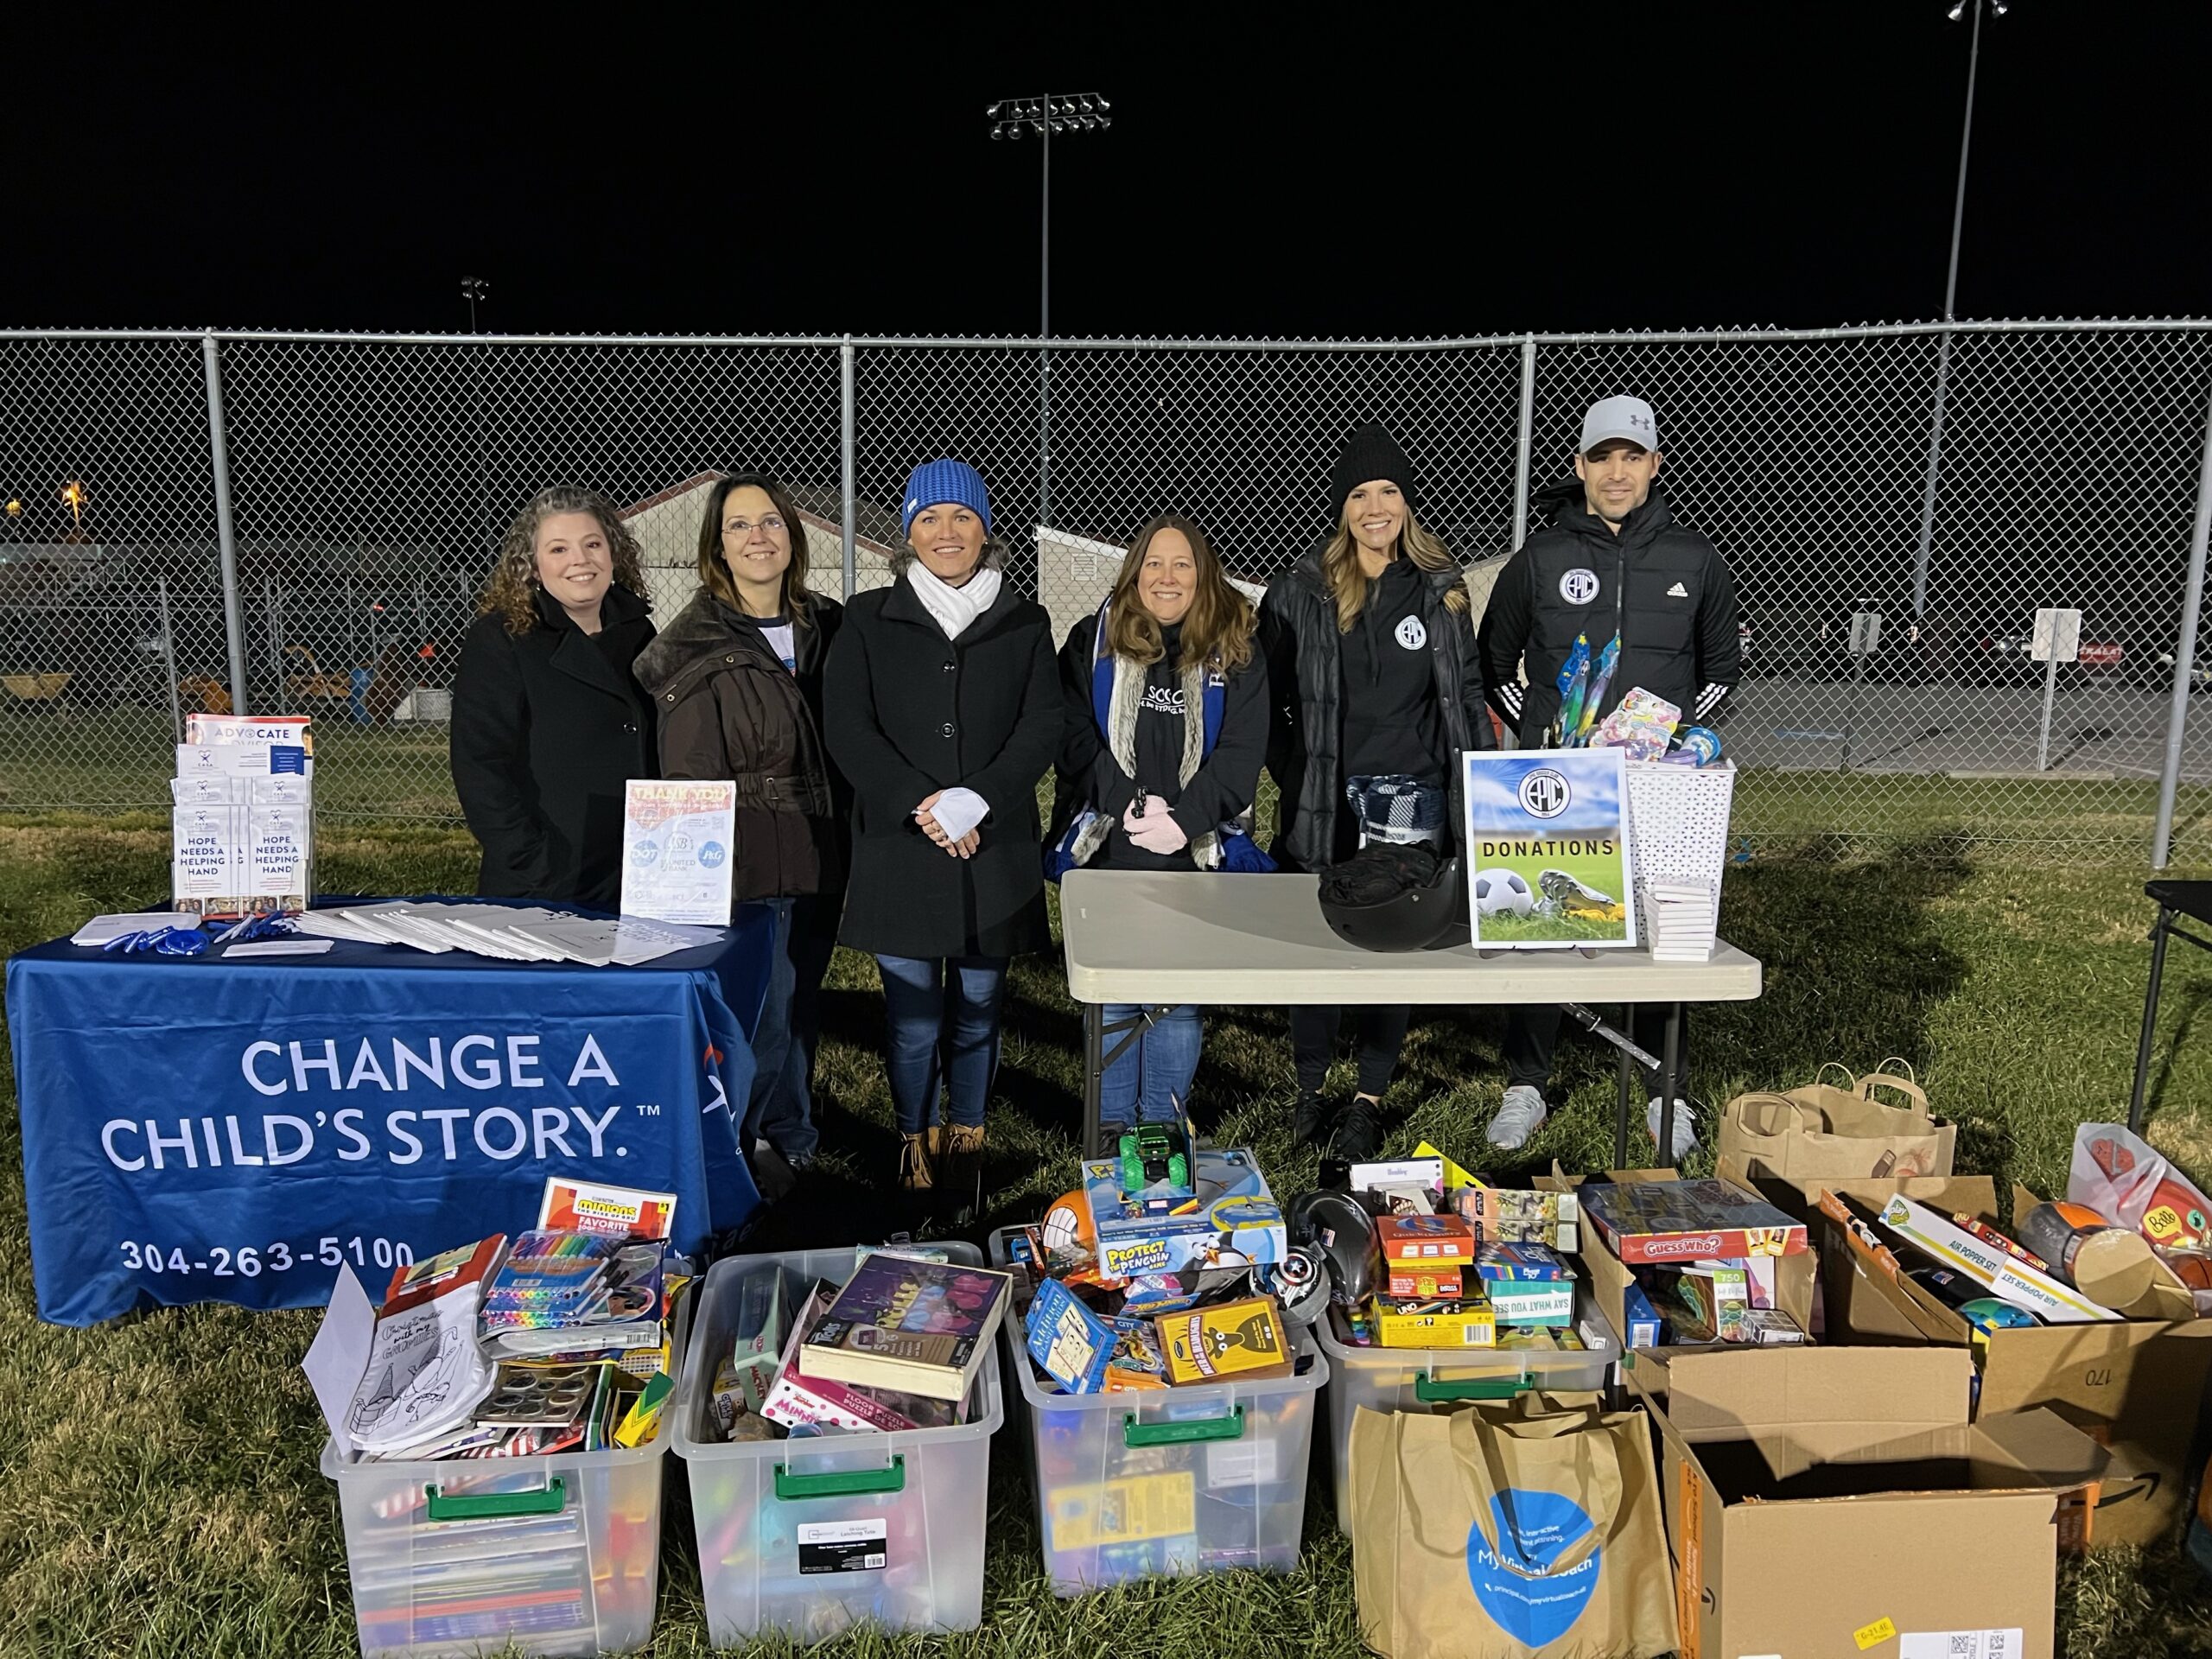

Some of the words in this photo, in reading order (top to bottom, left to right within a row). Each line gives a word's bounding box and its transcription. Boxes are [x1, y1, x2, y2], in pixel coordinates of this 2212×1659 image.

[214, 728, 289, 739] ADVOCATE
[1527, 777, 1562, 811] EPIC
[263, 836, 290, 844] HOPE
[1483, 840, 1613, 857] DONATIONS
[255, 855, 299, 864] HELPING
[242, 1034, 544, 1096] CHANGE
[567, 1033, 620, 1086] A
[101, 1109, 371, 1172] CHILD'S
[387, 1106, 627, 1165] STORY.
[578, 1217, 629, 1232] FAVORITE
[1107, 1241, 1166, 1265] PROTECT
[1647, 1242, 1684, 1255] Guess
[1685, 1238, 1720, 1252] Who?
[120, 1236, 415, 1277] 304-263-5100
[1120, 1253, 1170, 1274] PENGUIN
[1949, 1240, 1960, 1253] AIR
[1961, 1246, 1986, 1266] POPPER
[1984, 1258, 1997, 1272] SET
[1720, 1274, 1740, 1282] 750
[2001, 1273, 2015, 1284] SET
[2015, 1280, 2044, 1300] POPPER
[1397, 1302, 1417, 1315] UNO
[1495, 1303, 1510, 1314] SEE
[1511, 1302, 1528, 1313] YOU
[1530, 1300, 1552, 1312] WHAT
[1554, 1299, 1569, 1310] SAY
[2044, 1297, 2059, 1306] AIR
[383, 1326, 439, 1360] GNOMIES
[749, 1365, 766, 1400] MICKEY
[2086, 1370, 2112, 1385] 170
[843, 1399, 873, 1417] PUZZLE
[874, 1414, 886, 1424] DE
[846, 1393, 874, 1412] FLOOR
[876, 1409, 905, 1427] PUZZLE
